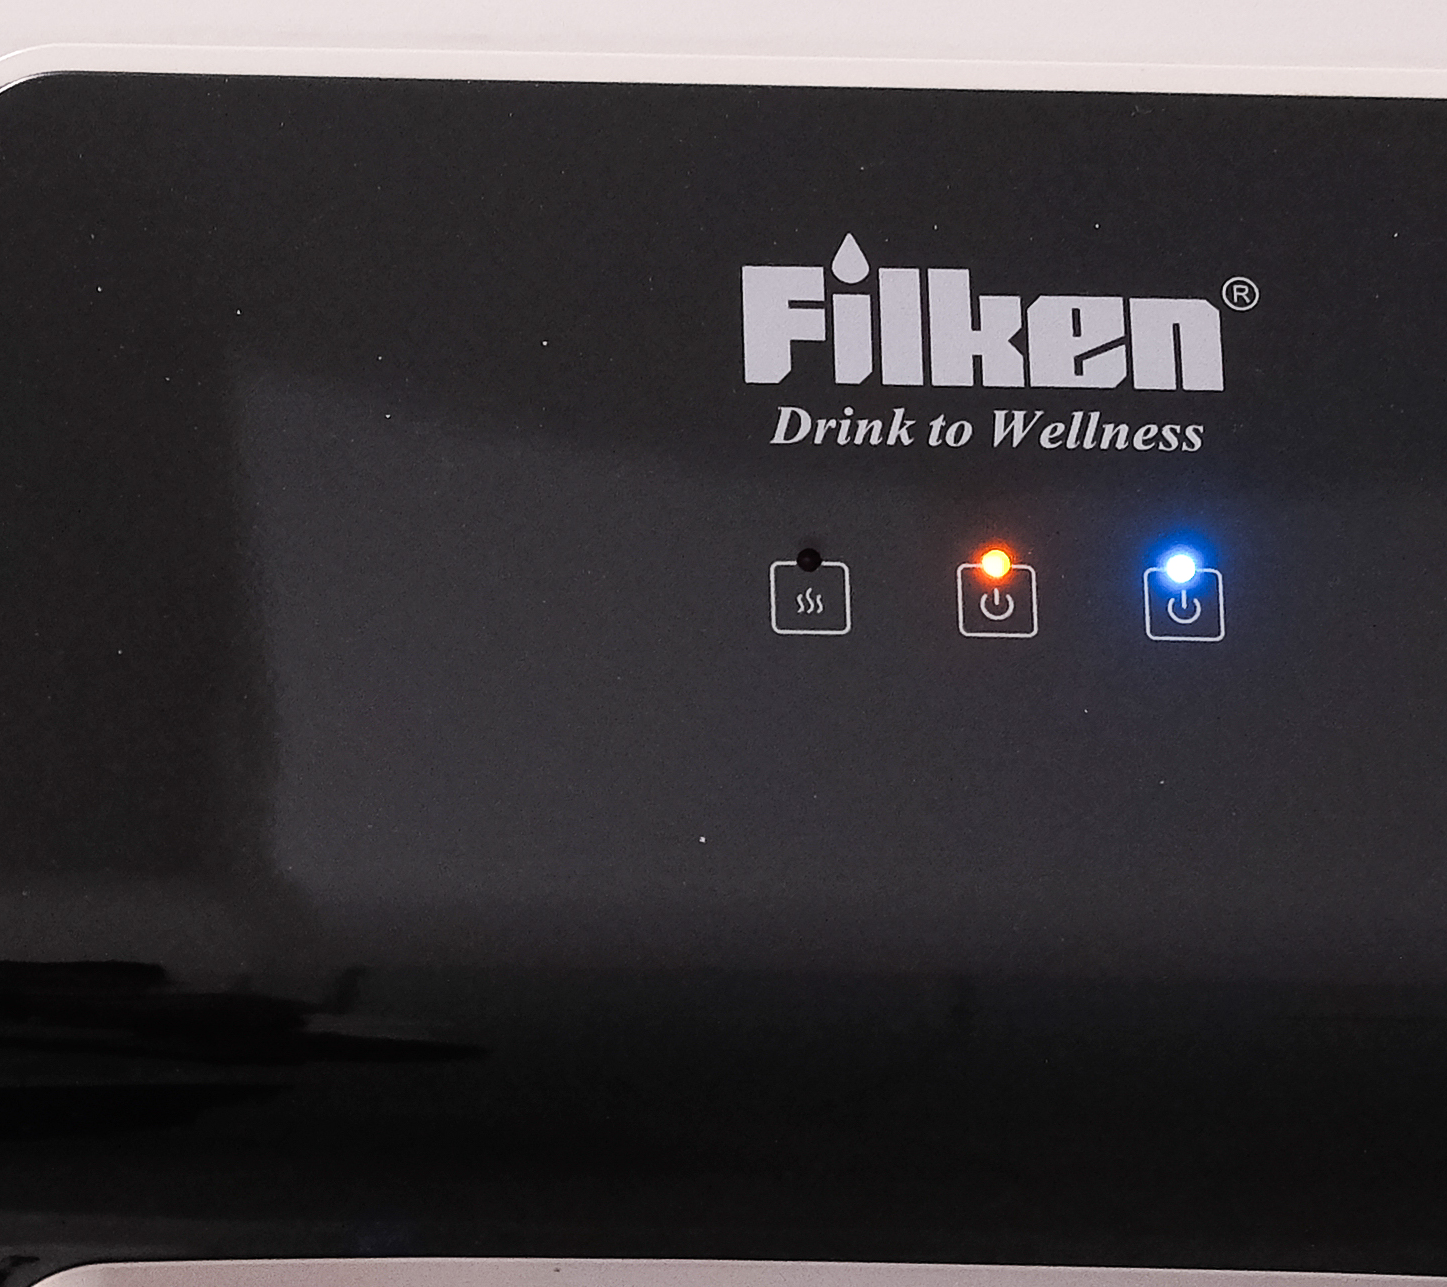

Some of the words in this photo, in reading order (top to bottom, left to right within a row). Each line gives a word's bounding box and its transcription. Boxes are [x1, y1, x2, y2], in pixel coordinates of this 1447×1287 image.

[770, 406, 917, 446] Drink
[928, 411, 973, 448] to
[991, 409, 1205, 452] Wellness
